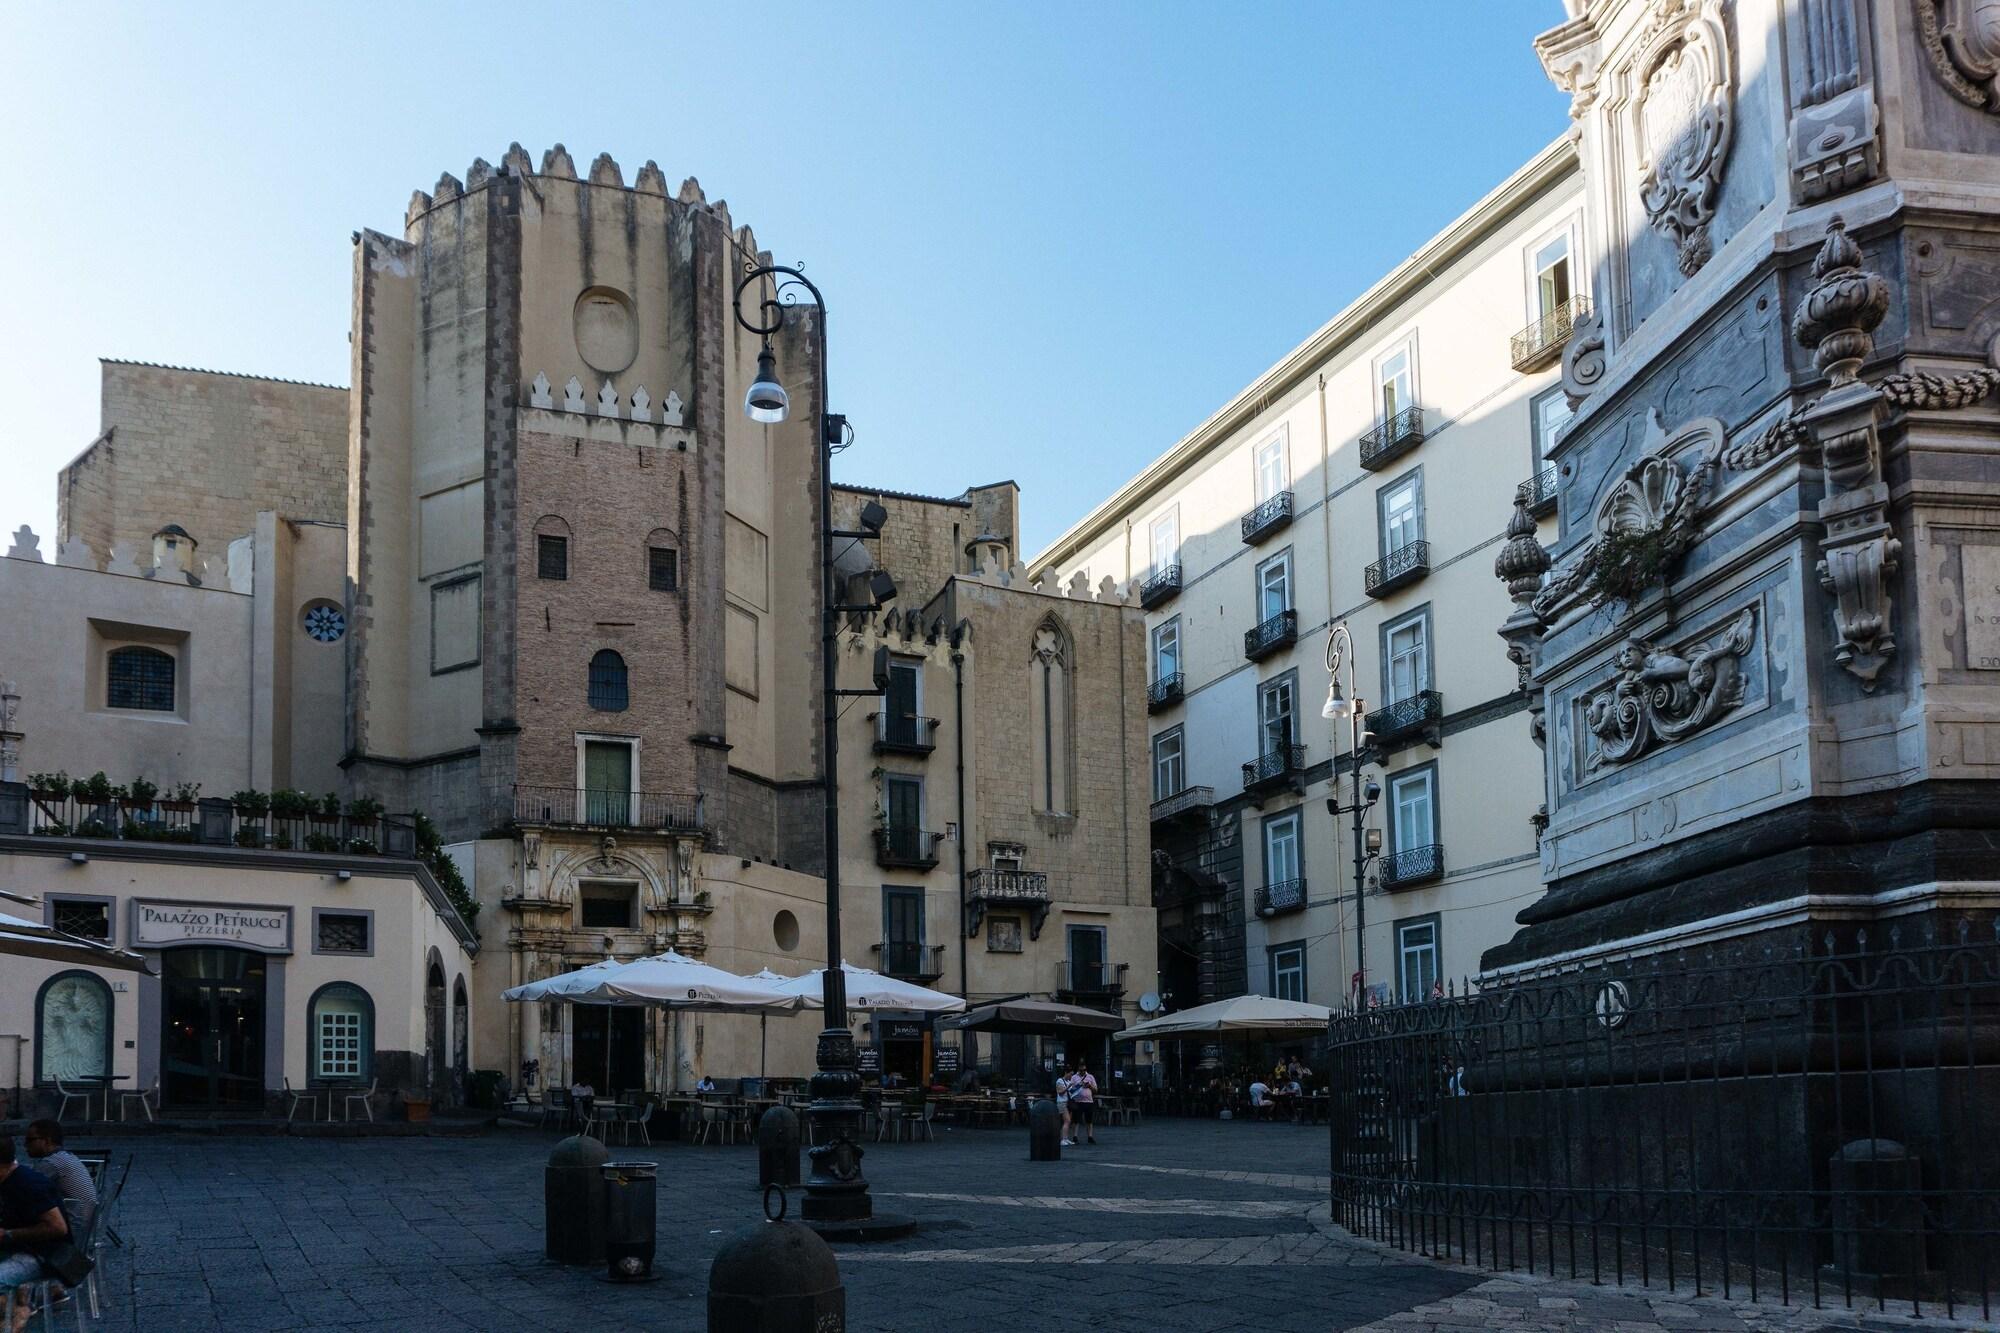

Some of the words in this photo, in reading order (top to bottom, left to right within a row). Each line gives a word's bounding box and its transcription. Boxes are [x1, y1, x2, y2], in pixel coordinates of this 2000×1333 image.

[144, 908, 209, 925] PALAZZO
[215, 912, 281, 929] PETRUCCI
[184, 925, 243, 936] PIZZERIA
